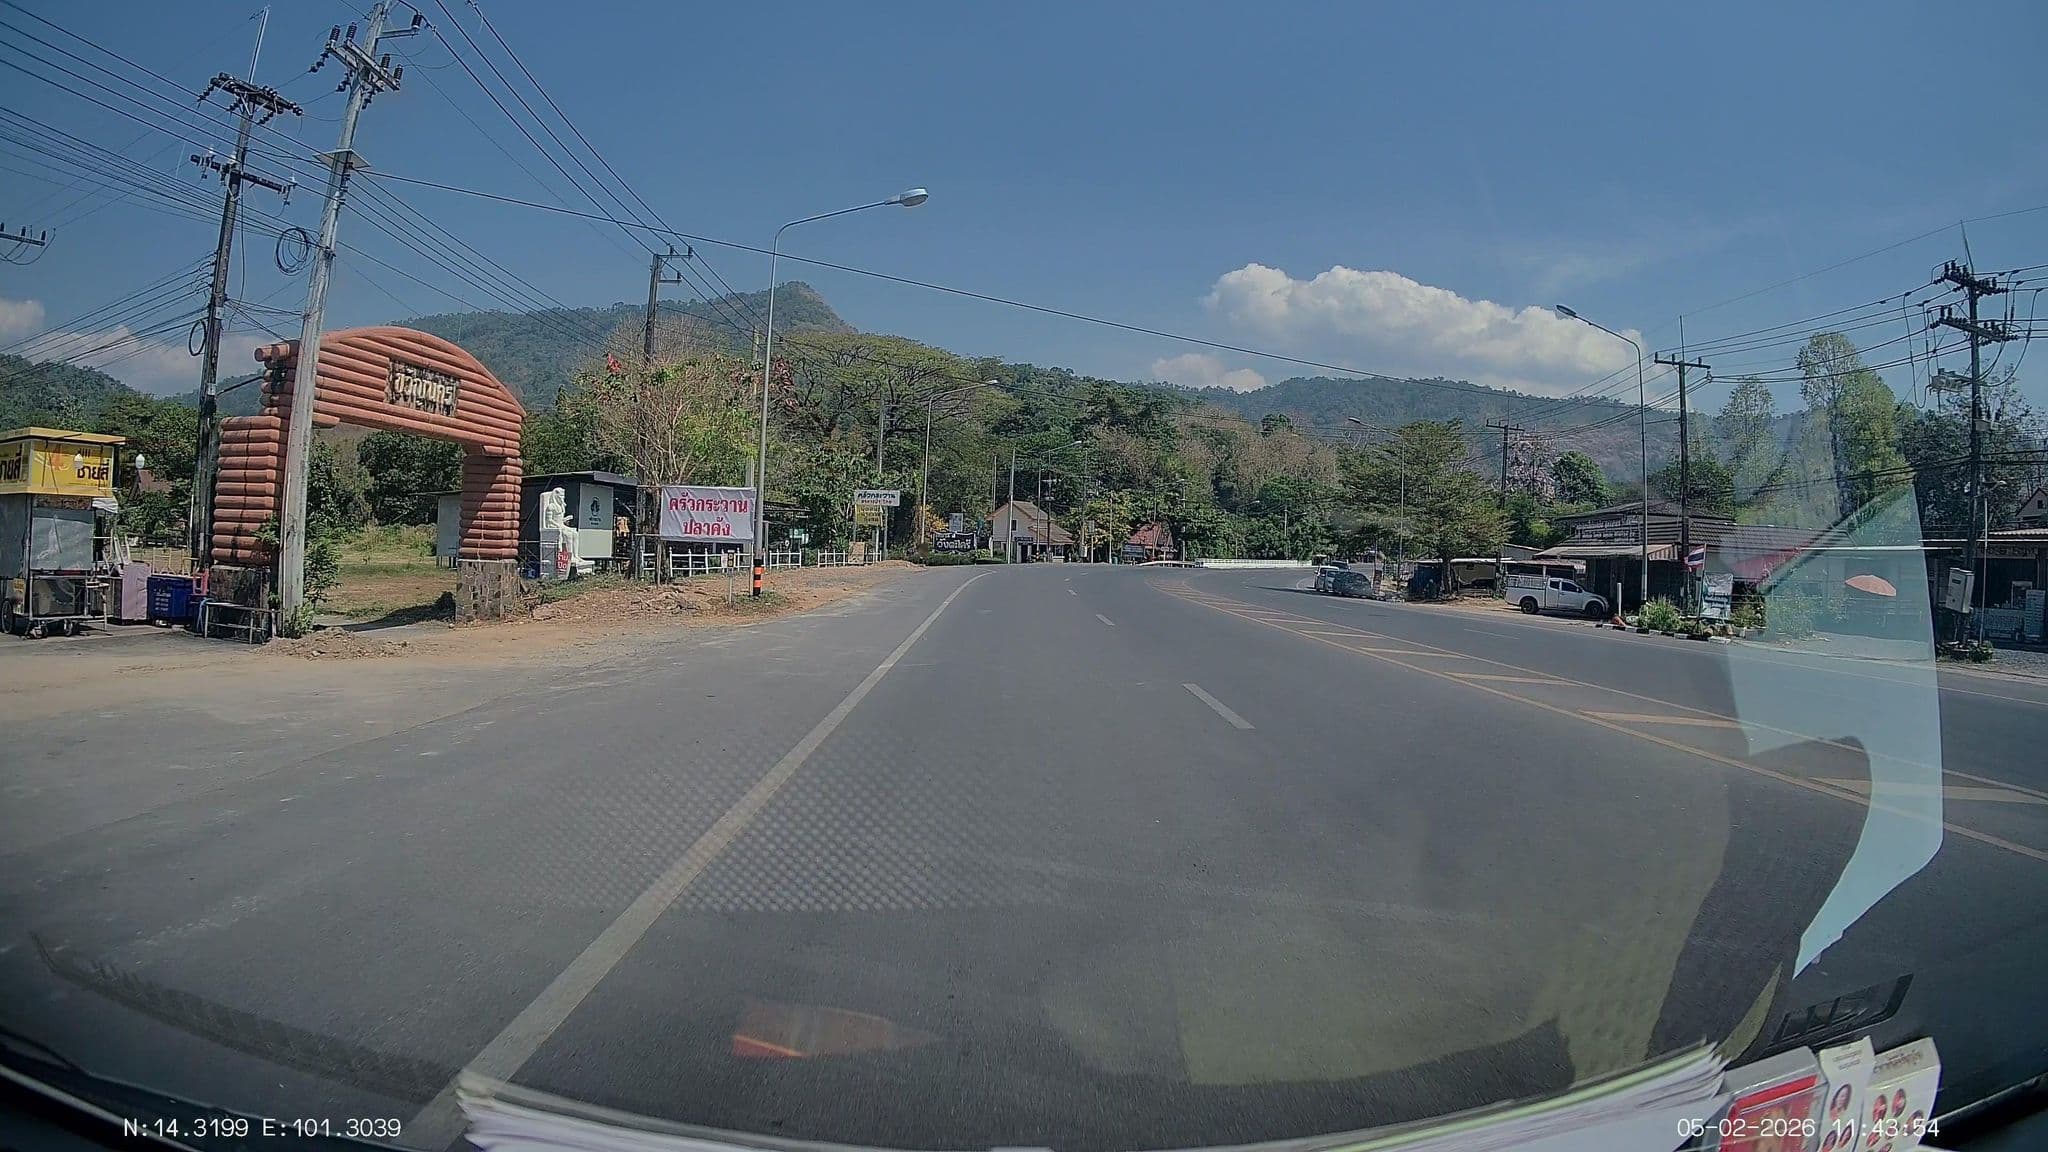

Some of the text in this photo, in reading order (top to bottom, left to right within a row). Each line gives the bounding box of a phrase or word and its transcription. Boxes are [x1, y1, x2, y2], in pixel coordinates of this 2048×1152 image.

[0, 444, 23, 480] ายสี่
[77, 459, 110, 480] ชายสี่
[669, 492, 748, 513] ครัวกระวาน
[683, 516, 731, 536] ปลาคัง
